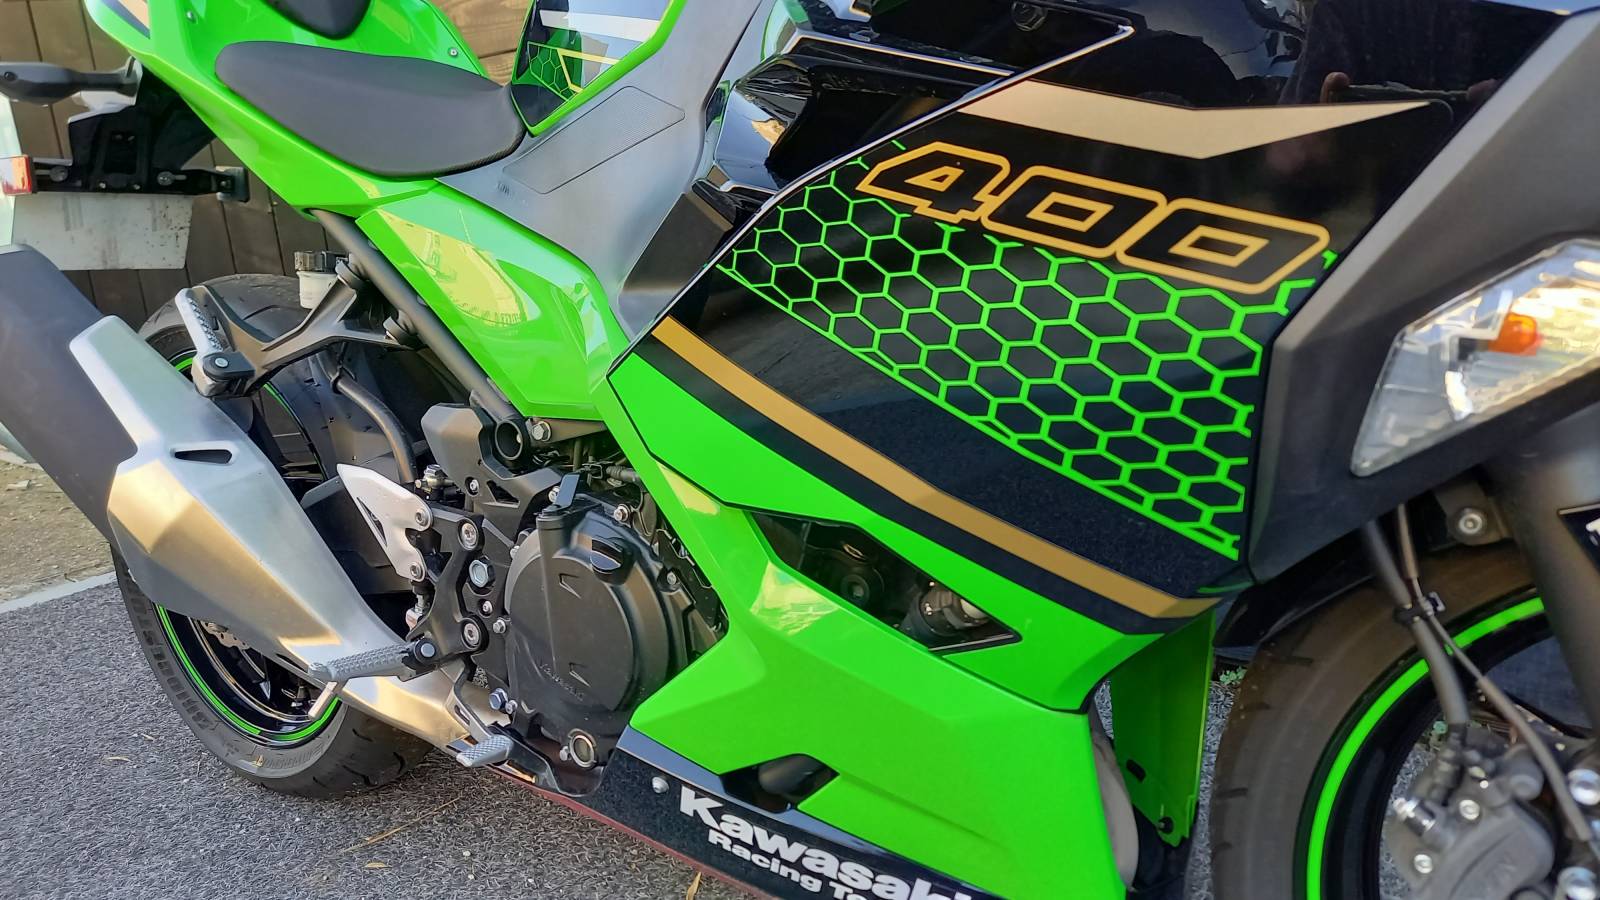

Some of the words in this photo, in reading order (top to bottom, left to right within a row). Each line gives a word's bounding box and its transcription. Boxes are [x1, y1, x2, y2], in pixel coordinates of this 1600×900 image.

[856, 141, 1330, 294] 400
[680, 785, 972, 900] Kawasak
[708, 829, 822, 893] Racing
